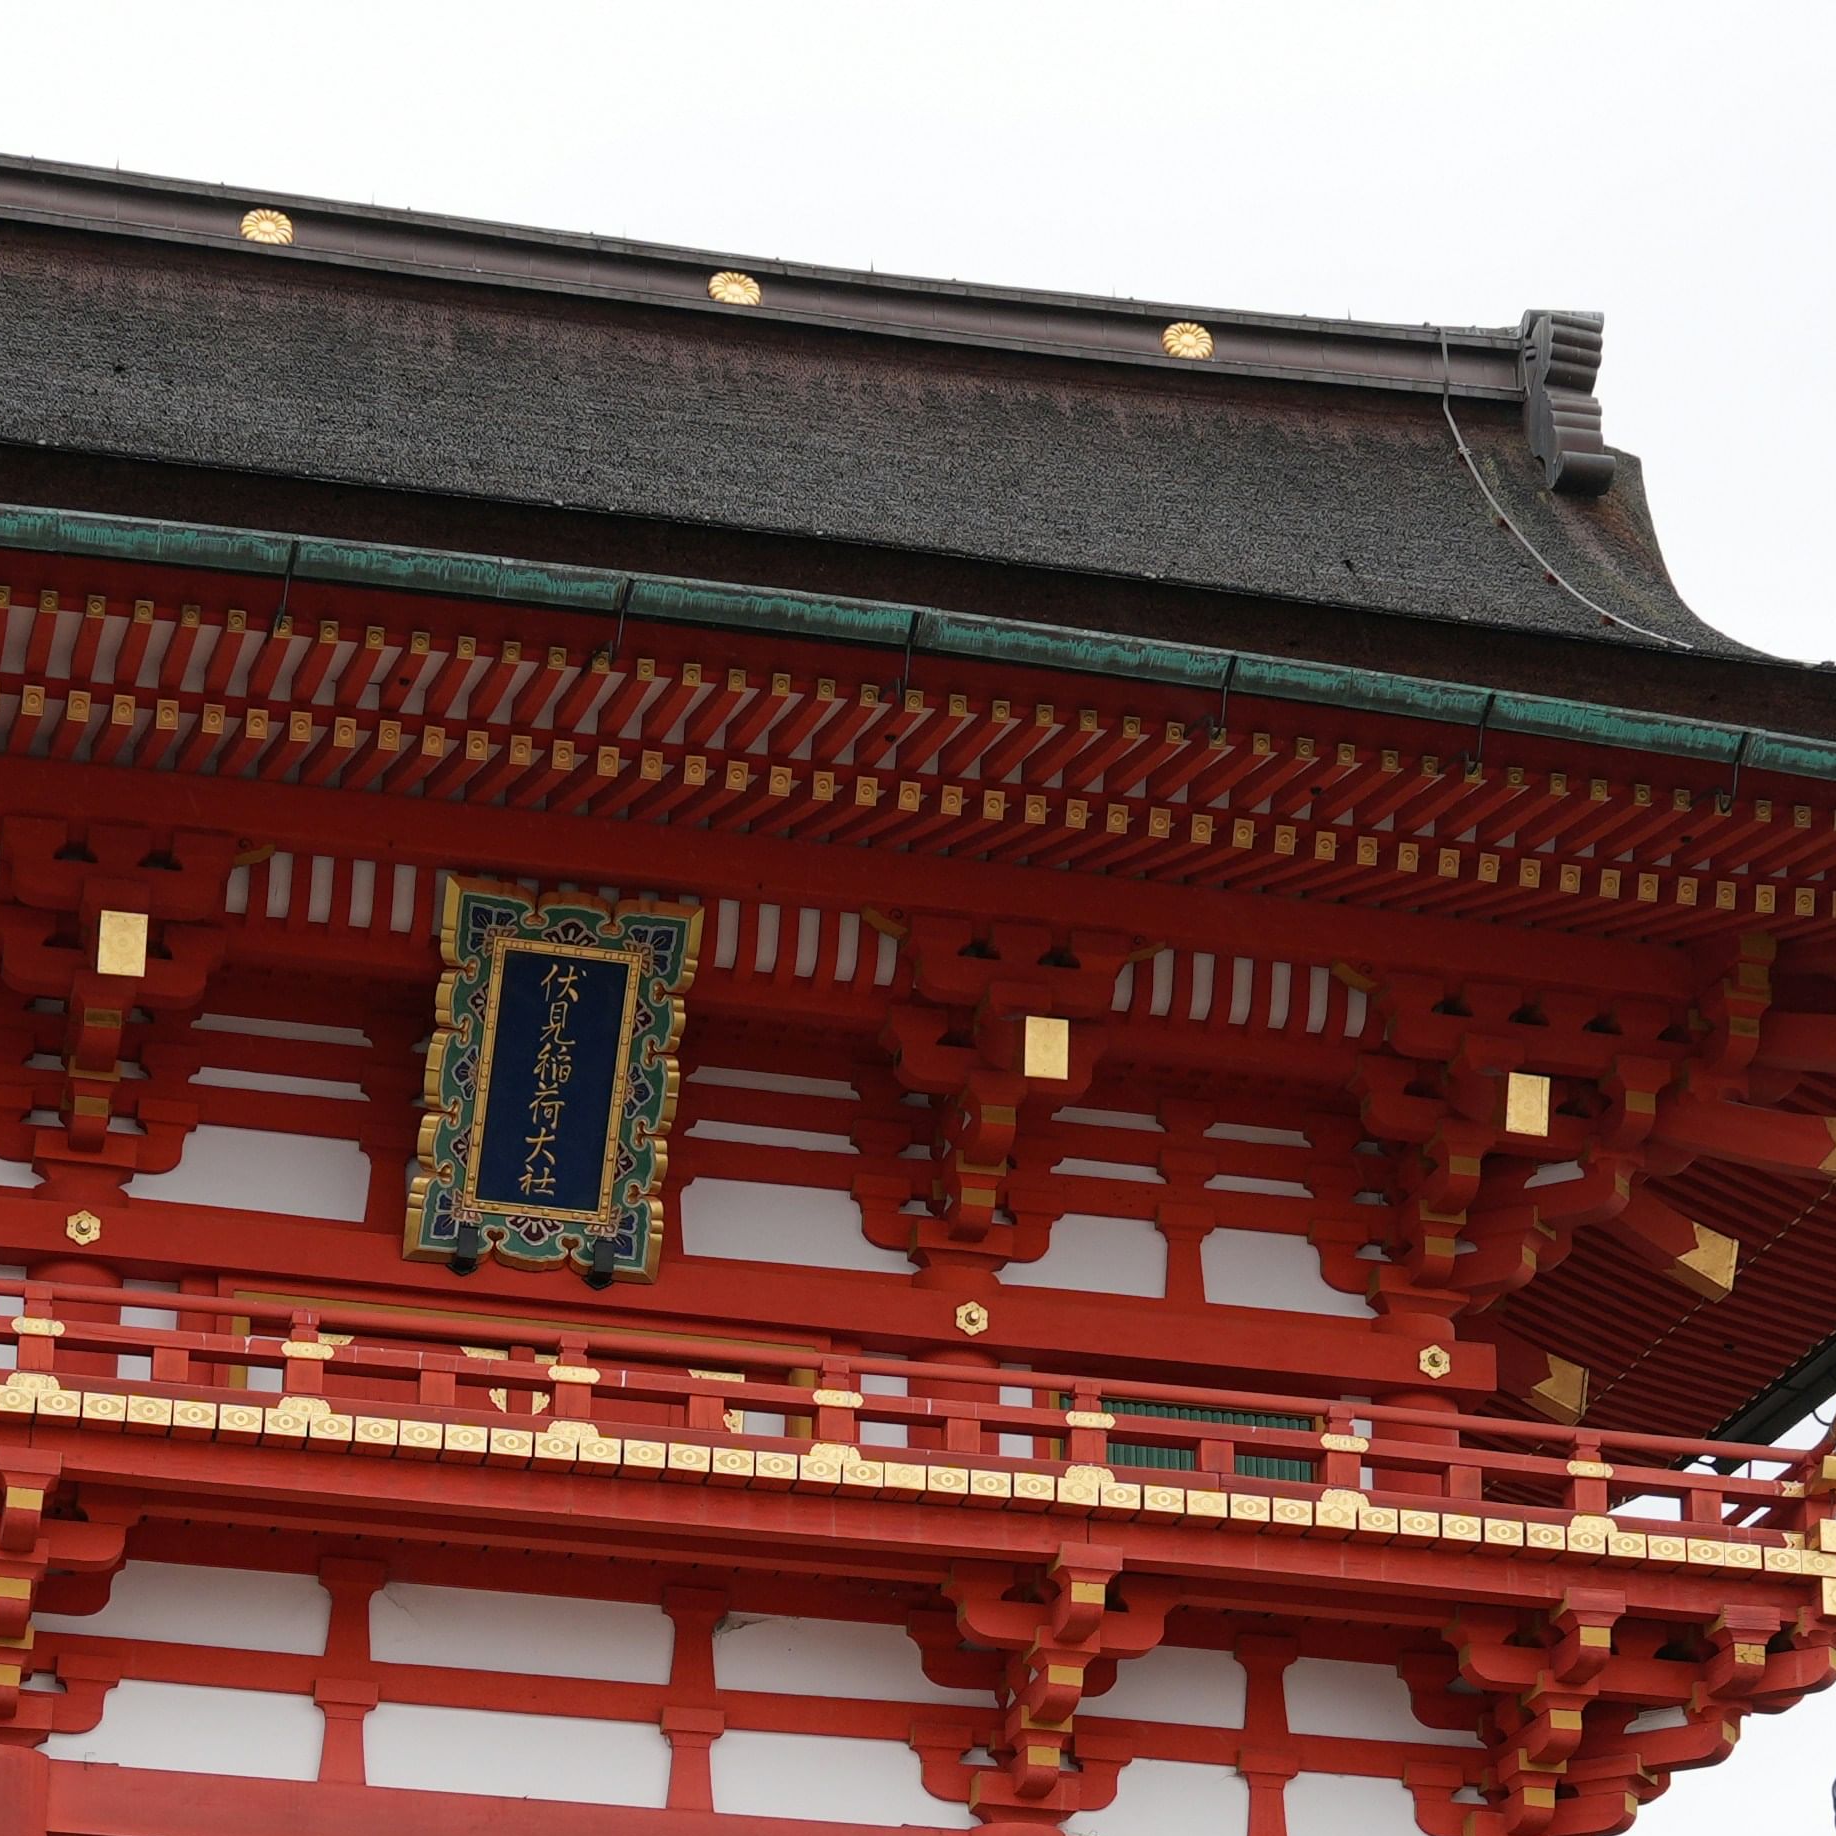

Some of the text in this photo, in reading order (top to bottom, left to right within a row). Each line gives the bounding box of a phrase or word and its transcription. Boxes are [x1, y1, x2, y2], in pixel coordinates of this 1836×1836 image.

[517, 962, 588, 1197] 伏見稲荷大社
